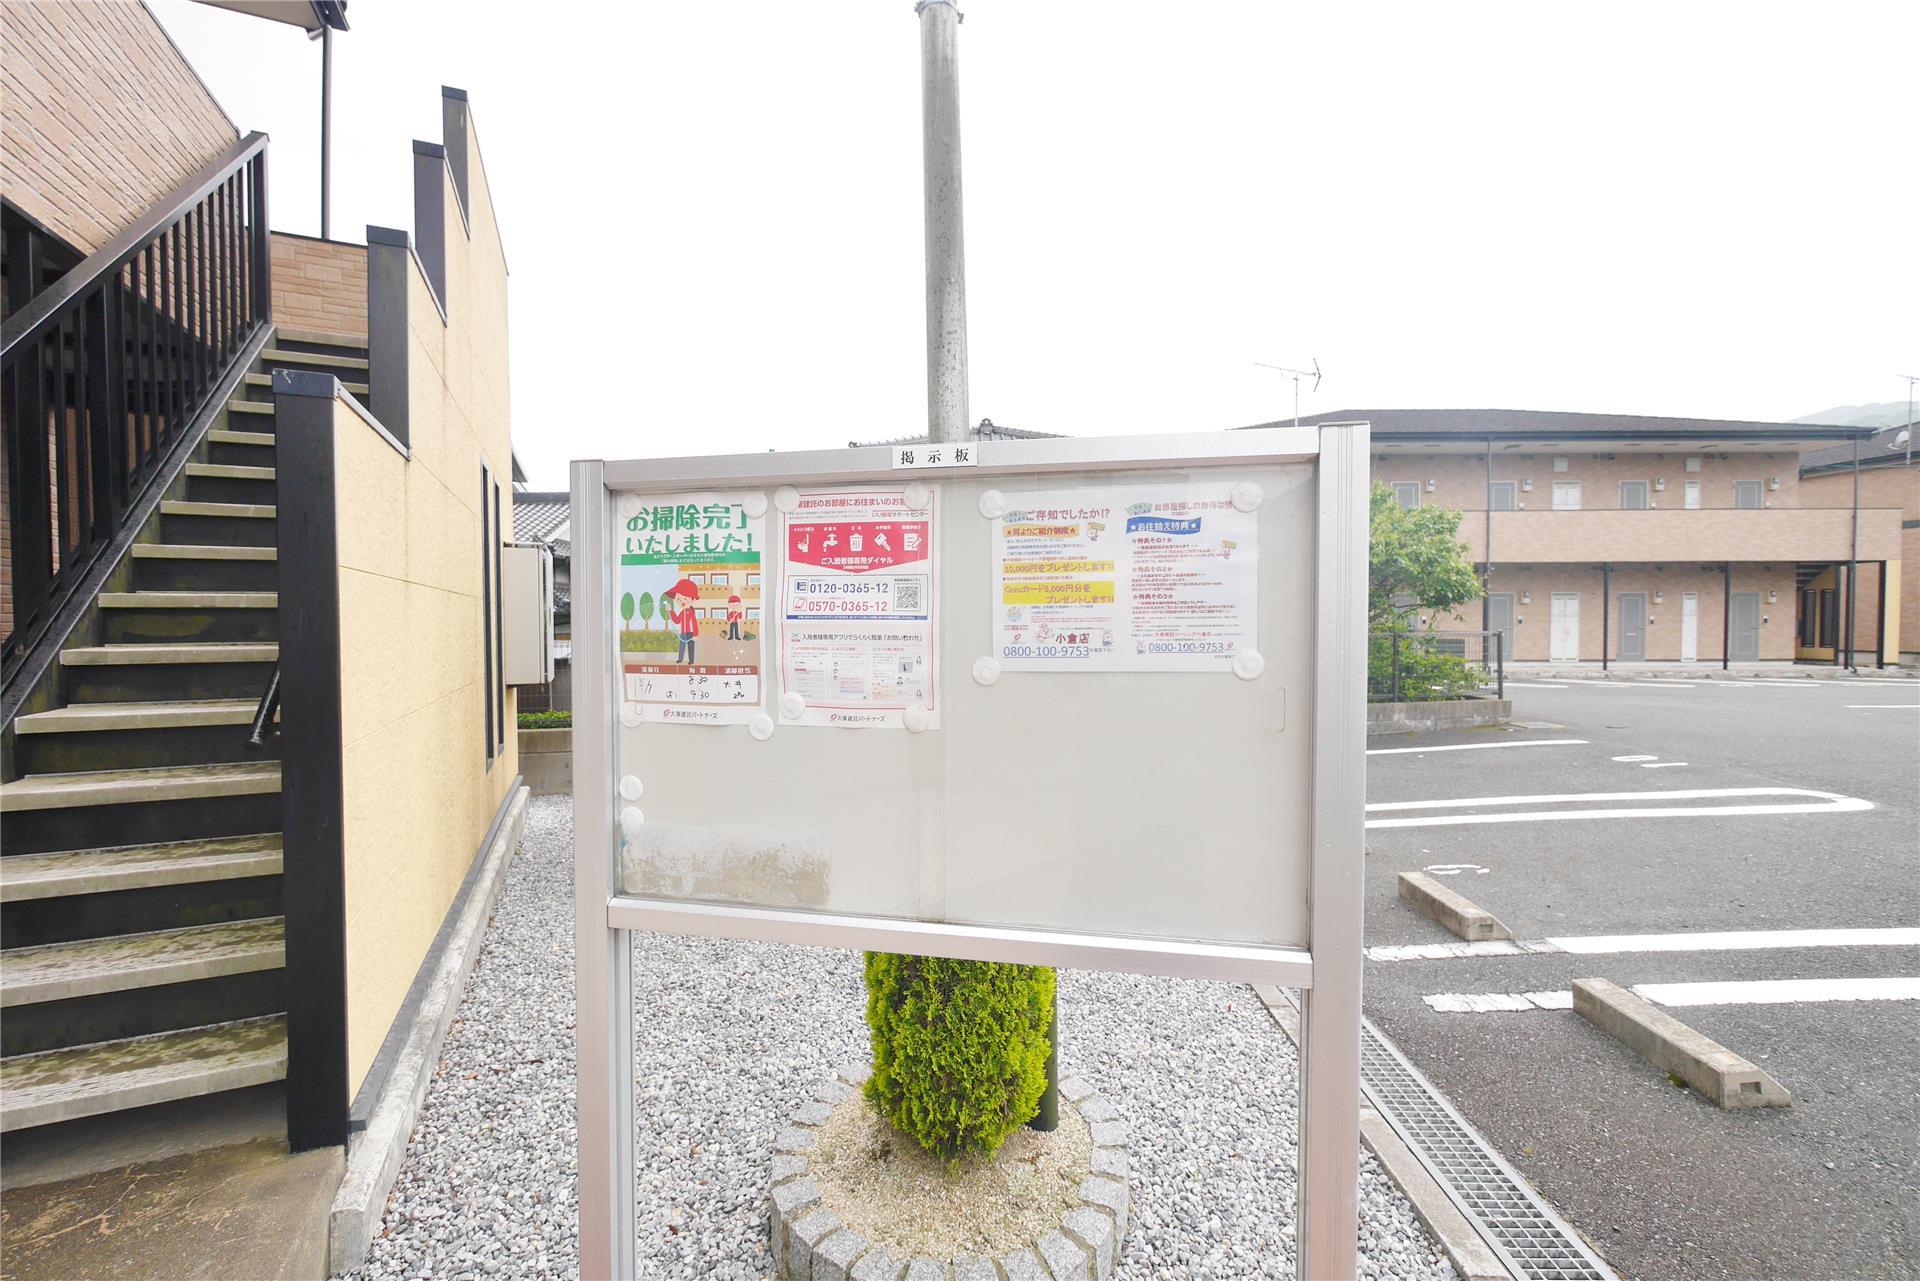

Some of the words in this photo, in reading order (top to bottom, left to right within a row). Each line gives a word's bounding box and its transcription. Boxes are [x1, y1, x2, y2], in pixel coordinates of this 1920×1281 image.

[901, 448, 969, 465] 掲示板
[626, 503, 748, 532] お掃除完了
[626, 533, 753, 554] いたしました!
[809, 583, 889, 594] 0120-0365-12
[808, 601, 888, 612] 0570-0365-12
[1056, 632, 1090, 645] 小倉店
[1003, 646, 1090, 657] 0800-100-9753
[1148, 642, 1224, 653] 0800-100-9753
